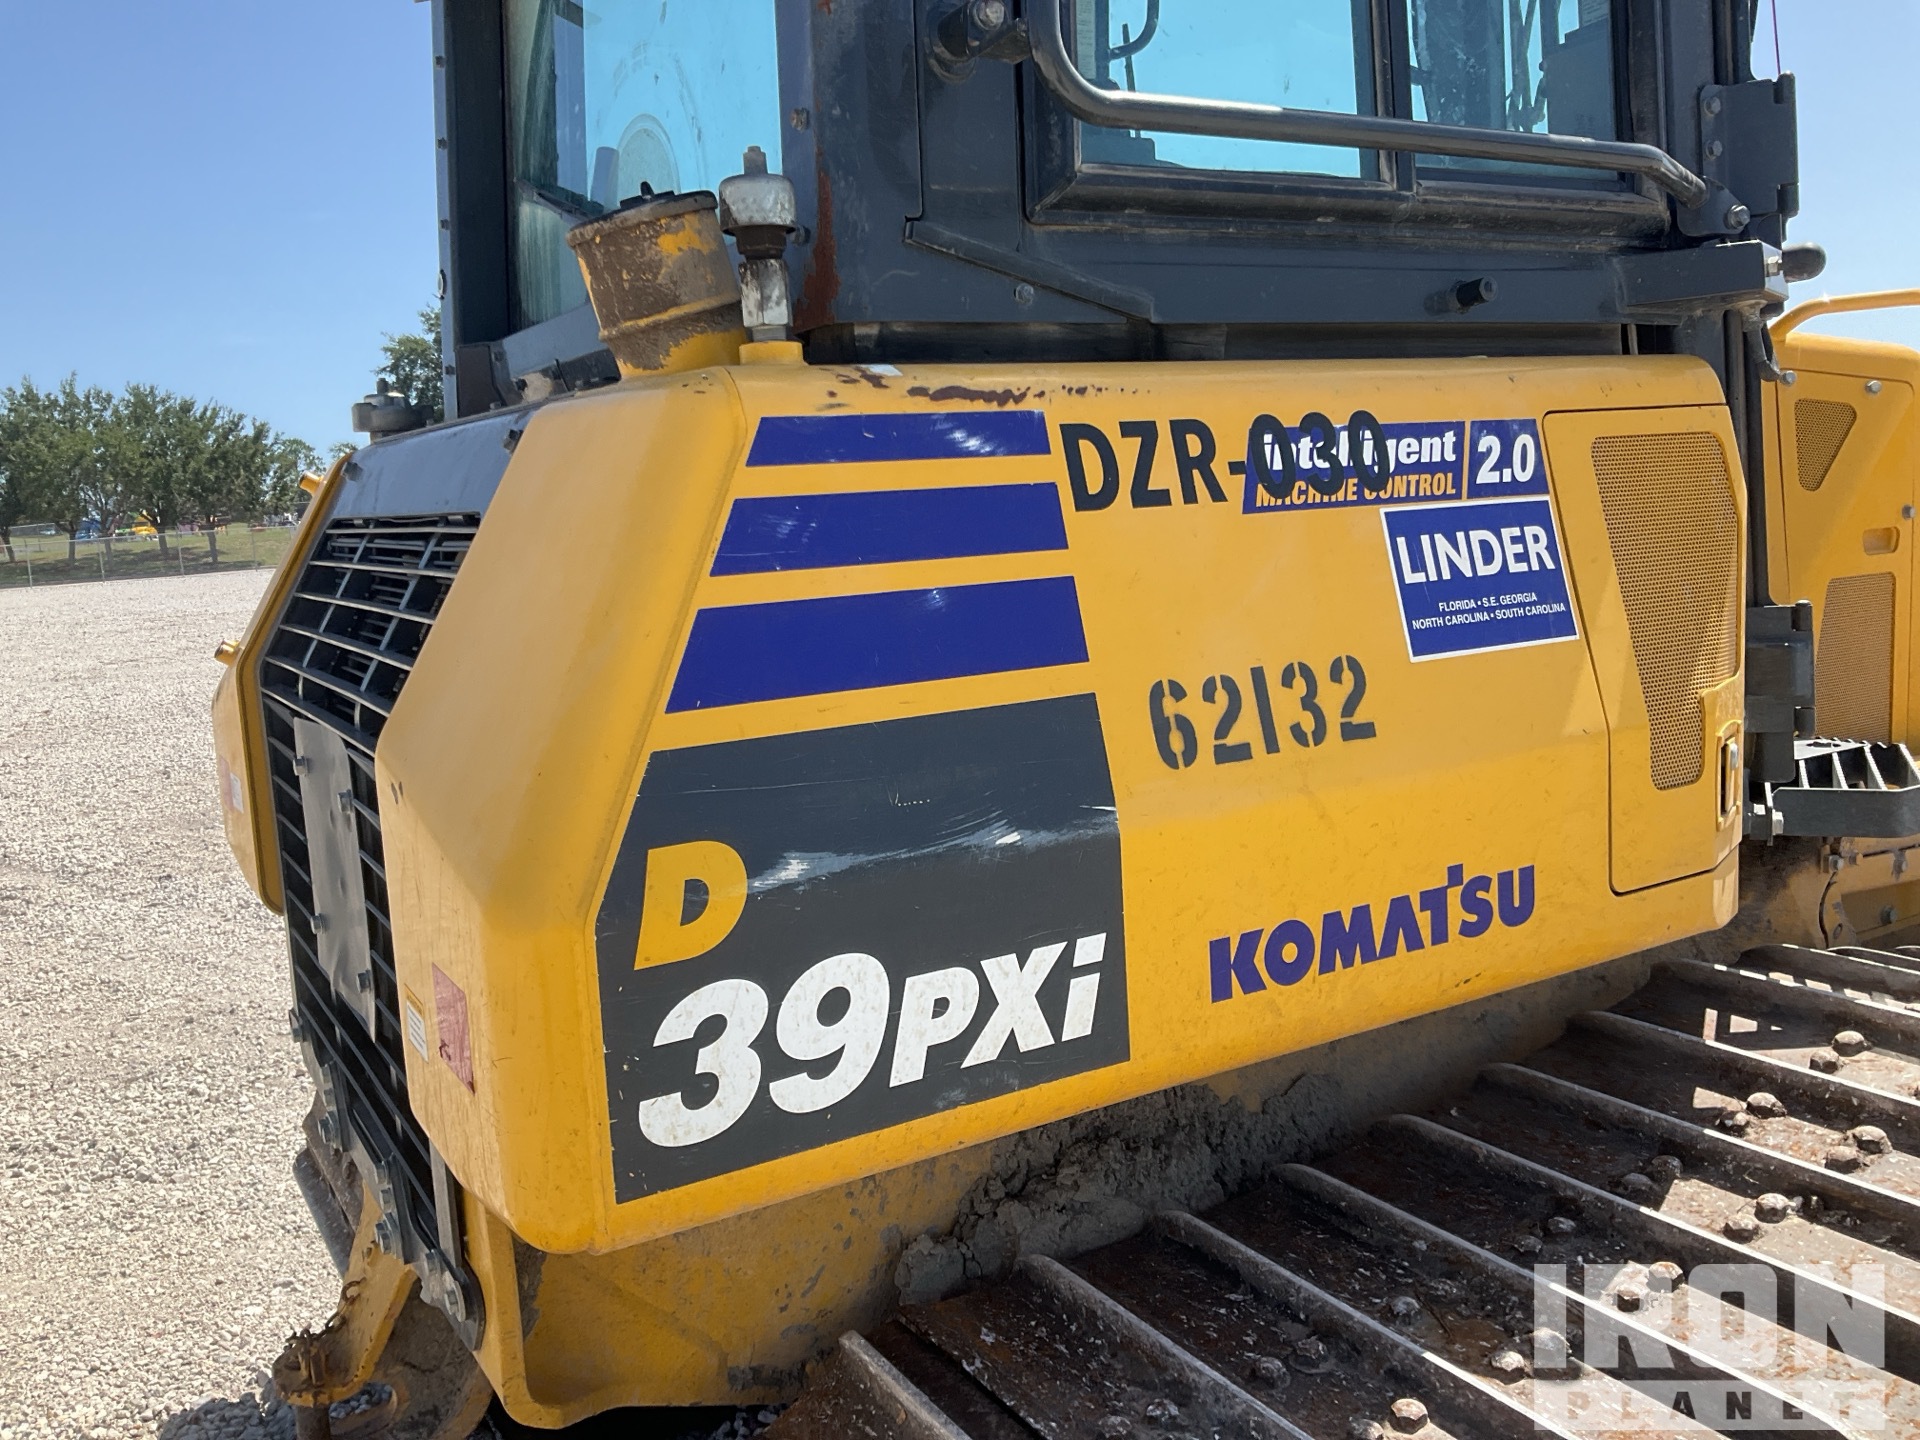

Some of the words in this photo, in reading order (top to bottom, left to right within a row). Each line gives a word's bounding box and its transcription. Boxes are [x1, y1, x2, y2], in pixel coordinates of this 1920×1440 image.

[1059, 410, 1391, 512] DZR-030
[1475, 433, 1536, 485] 2.0
[1396, 525, 1556, 584] LINDER
[1411, 616, 1444, 630] NORTH
[1445, 610, 1490, 626] CAROLINA
[1495, 607, 1525, 620] SOUTH
[1525, 602, 1566, 616] CAROLINA
[1438, 598, 1477, 612] FLORIDA
[1482, 596, 1499, 608] S.E.
[1499, 592, 1538, 605] GEORGIA
[1149, 654, 1377, 770] 62132
[633, 840, 748, 971] D
[1208, 863, 1536, 1004] KOMATSU
